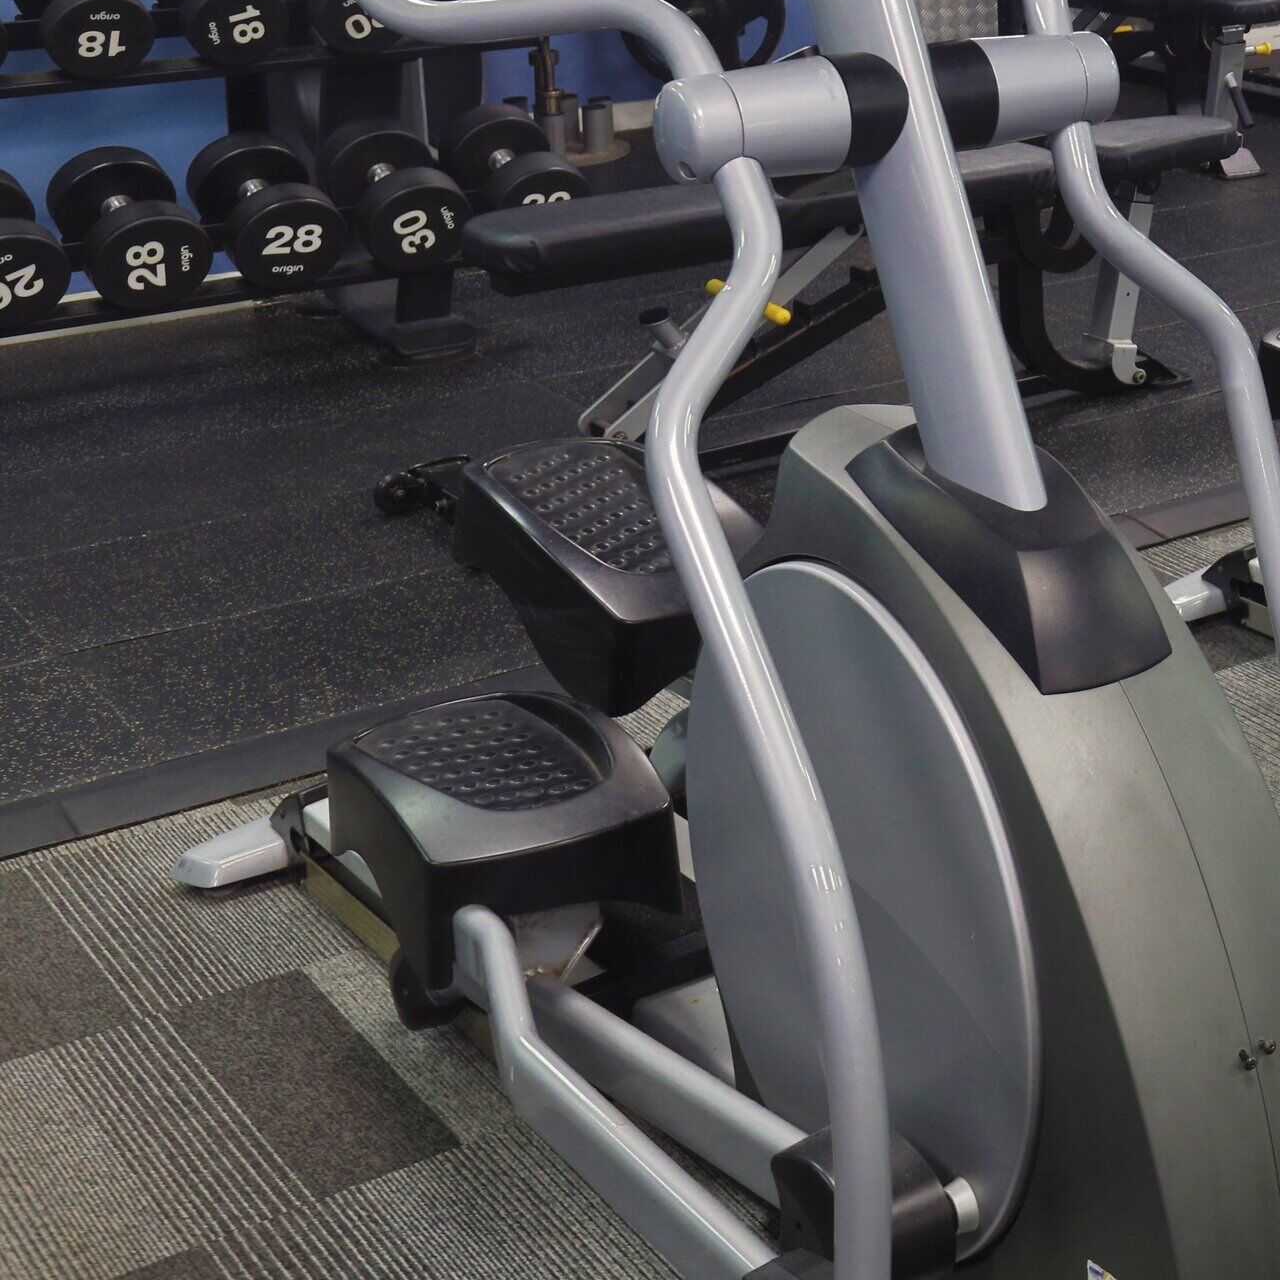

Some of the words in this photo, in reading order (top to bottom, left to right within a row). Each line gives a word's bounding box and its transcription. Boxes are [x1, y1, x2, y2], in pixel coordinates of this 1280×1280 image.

[90, 10, 121, 21] origin
[228, 4, 266, 44] 18
[77, 30, 126, 58] 18
[208, 21, 221, 45] origin
[440, 205, 455, 230] origin
[262, 224, 323, 256] 28
[393, 209, 437, 255] 30
[126, 241, 167, 291] 28
[180, 245, 193, 272] origin
[272, 264, 304, 275] origin
